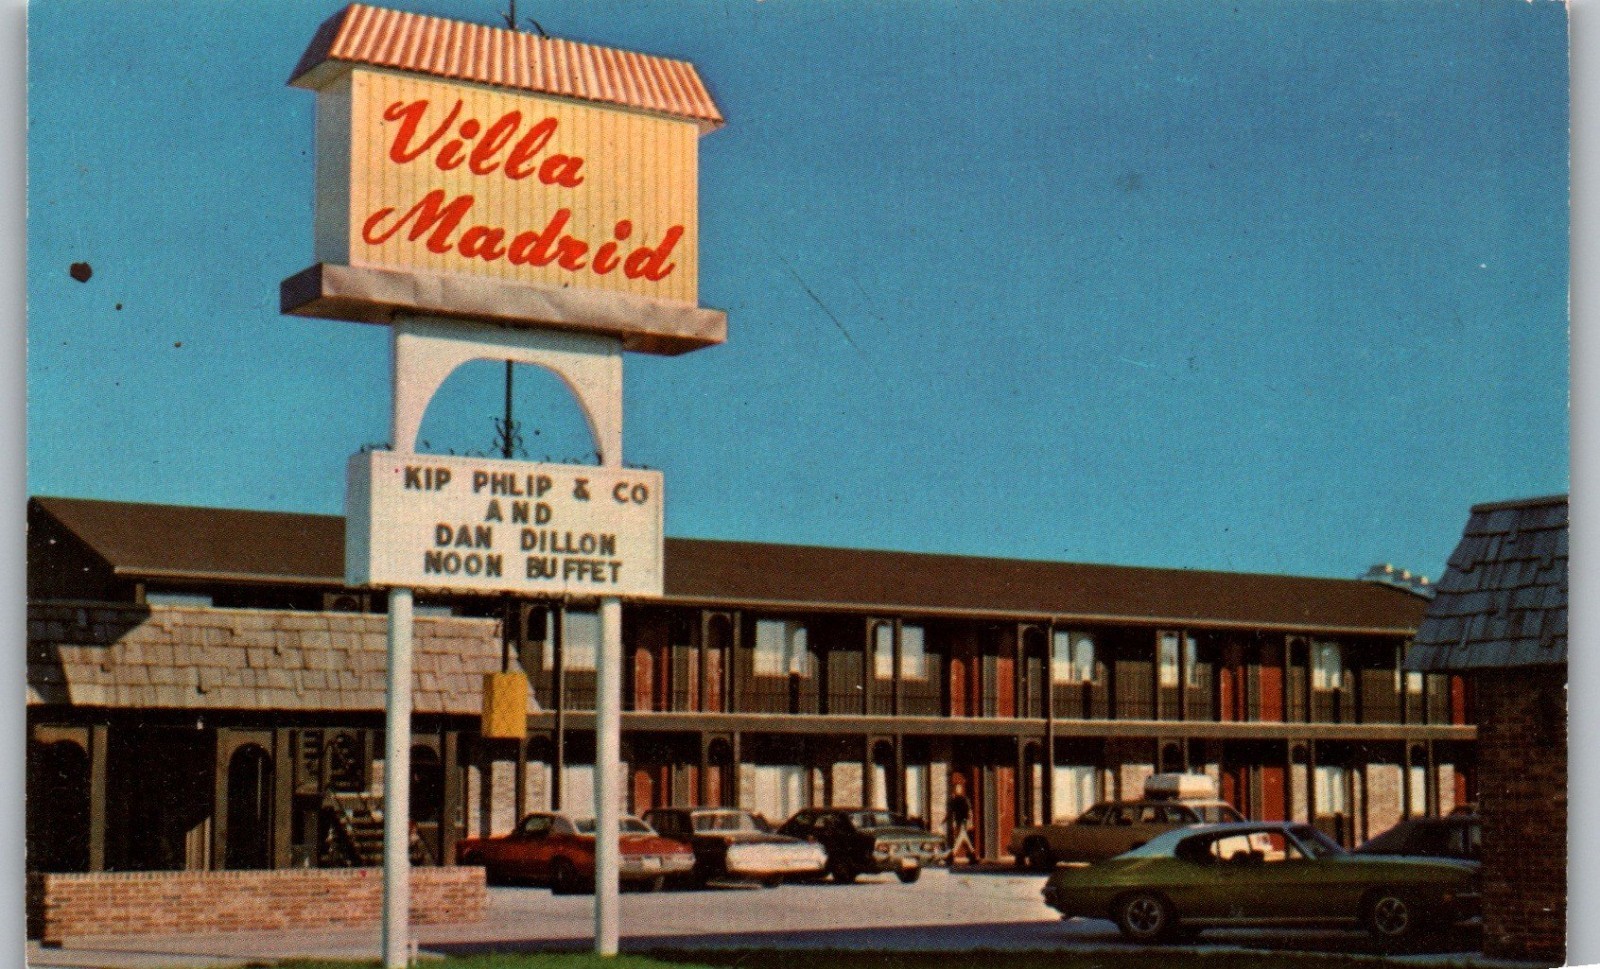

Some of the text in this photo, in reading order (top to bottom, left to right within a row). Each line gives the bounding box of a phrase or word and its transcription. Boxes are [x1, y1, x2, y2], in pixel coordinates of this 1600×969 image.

[383, 99, 584, 188] Villa
[362, 189, 684, 281] Madrid
[404, 466, 649, 505] KIP PHLIP & CO
[485, 500, 553, 525] AND
[435, 524, 617, 556] DAN DILLON
[425, 551, 623, 583] NOON BUFFET
